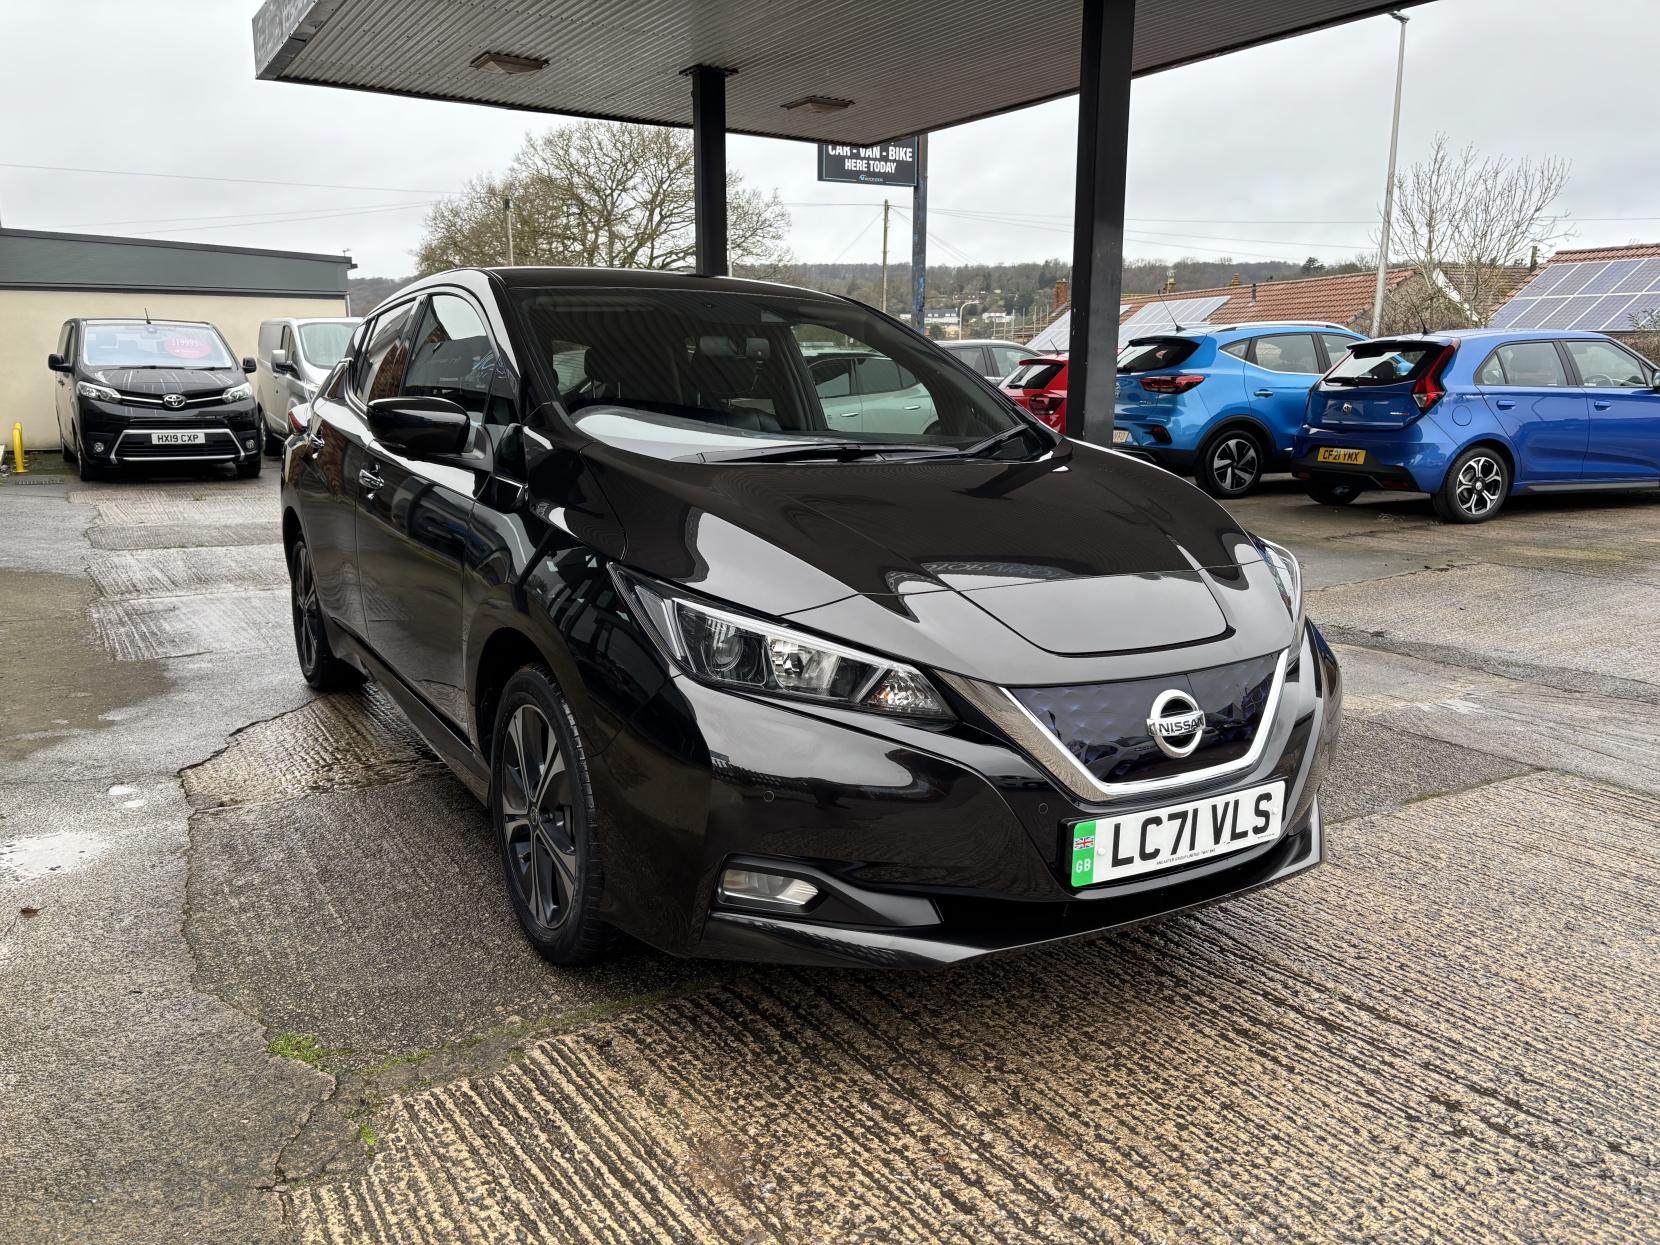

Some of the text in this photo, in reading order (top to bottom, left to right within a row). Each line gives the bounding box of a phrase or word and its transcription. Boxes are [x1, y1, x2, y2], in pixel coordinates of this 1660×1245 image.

[828, 145, 851, 156] CAR
[860, 146, 881, 159] VAN
[888, 146, 913, 161] BIKE
[845, 159, 897, 173] HERE TODAY
[157, 434, 199, 443] HX19 CXP
[1322, 449, 1360, 462] CF21 YMX
[1158, 718, 1205, 734] NISSAN
[1111, 792, 1273, 868] LC71 VLS
[1075, 858, 1091, 873] GB
